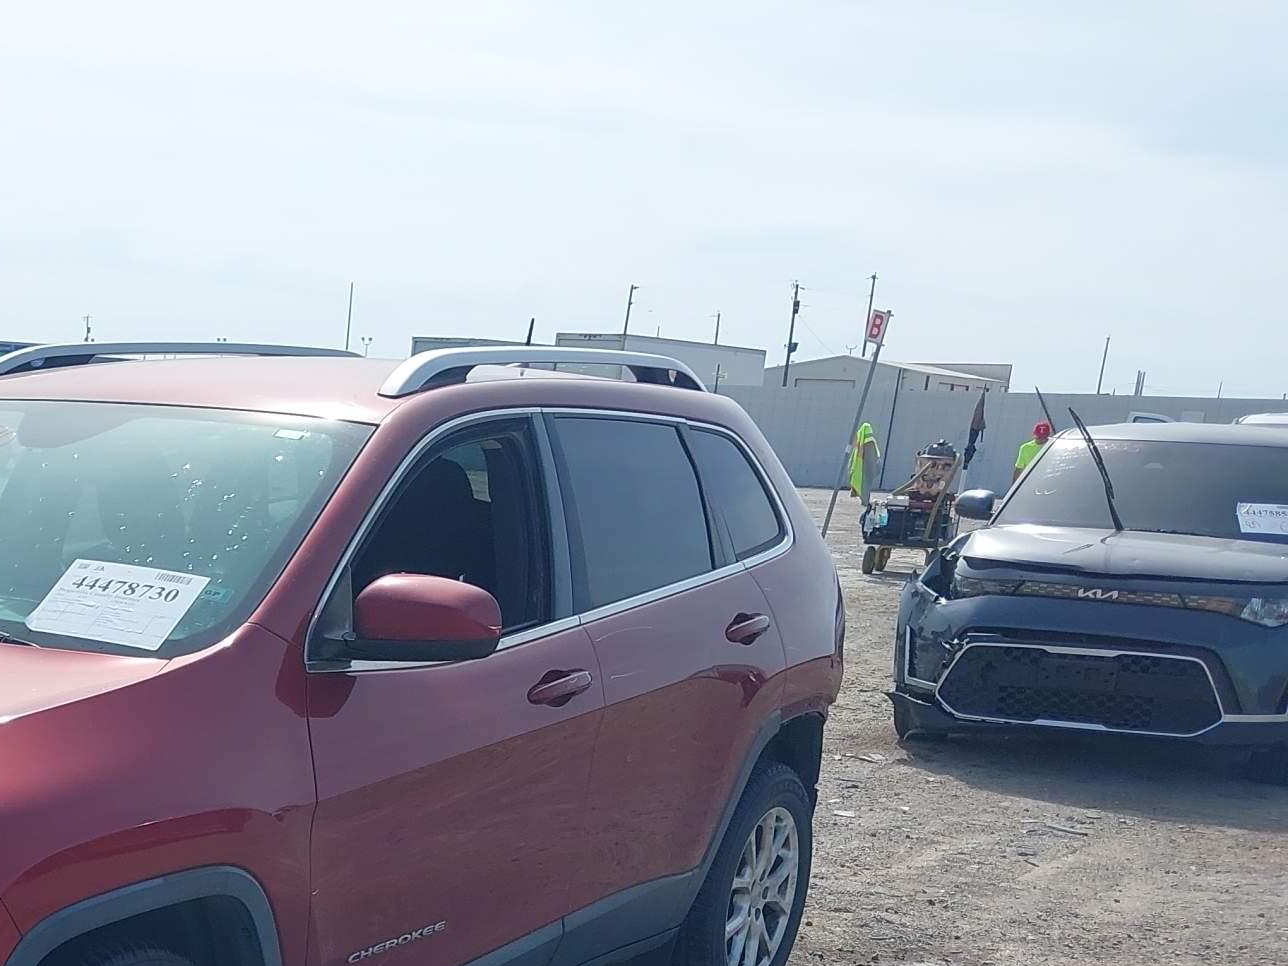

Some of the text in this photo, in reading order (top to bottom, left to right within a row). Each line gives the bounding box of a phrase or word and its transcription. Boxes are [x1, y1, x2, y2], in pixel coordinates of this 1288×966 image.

[868, 314, 884, 339] B
[72, 575, 180, 603] 44478730
[1077, 588, 1119, 599] KIA
[347, 920, 447, 964] CHEROKEE
